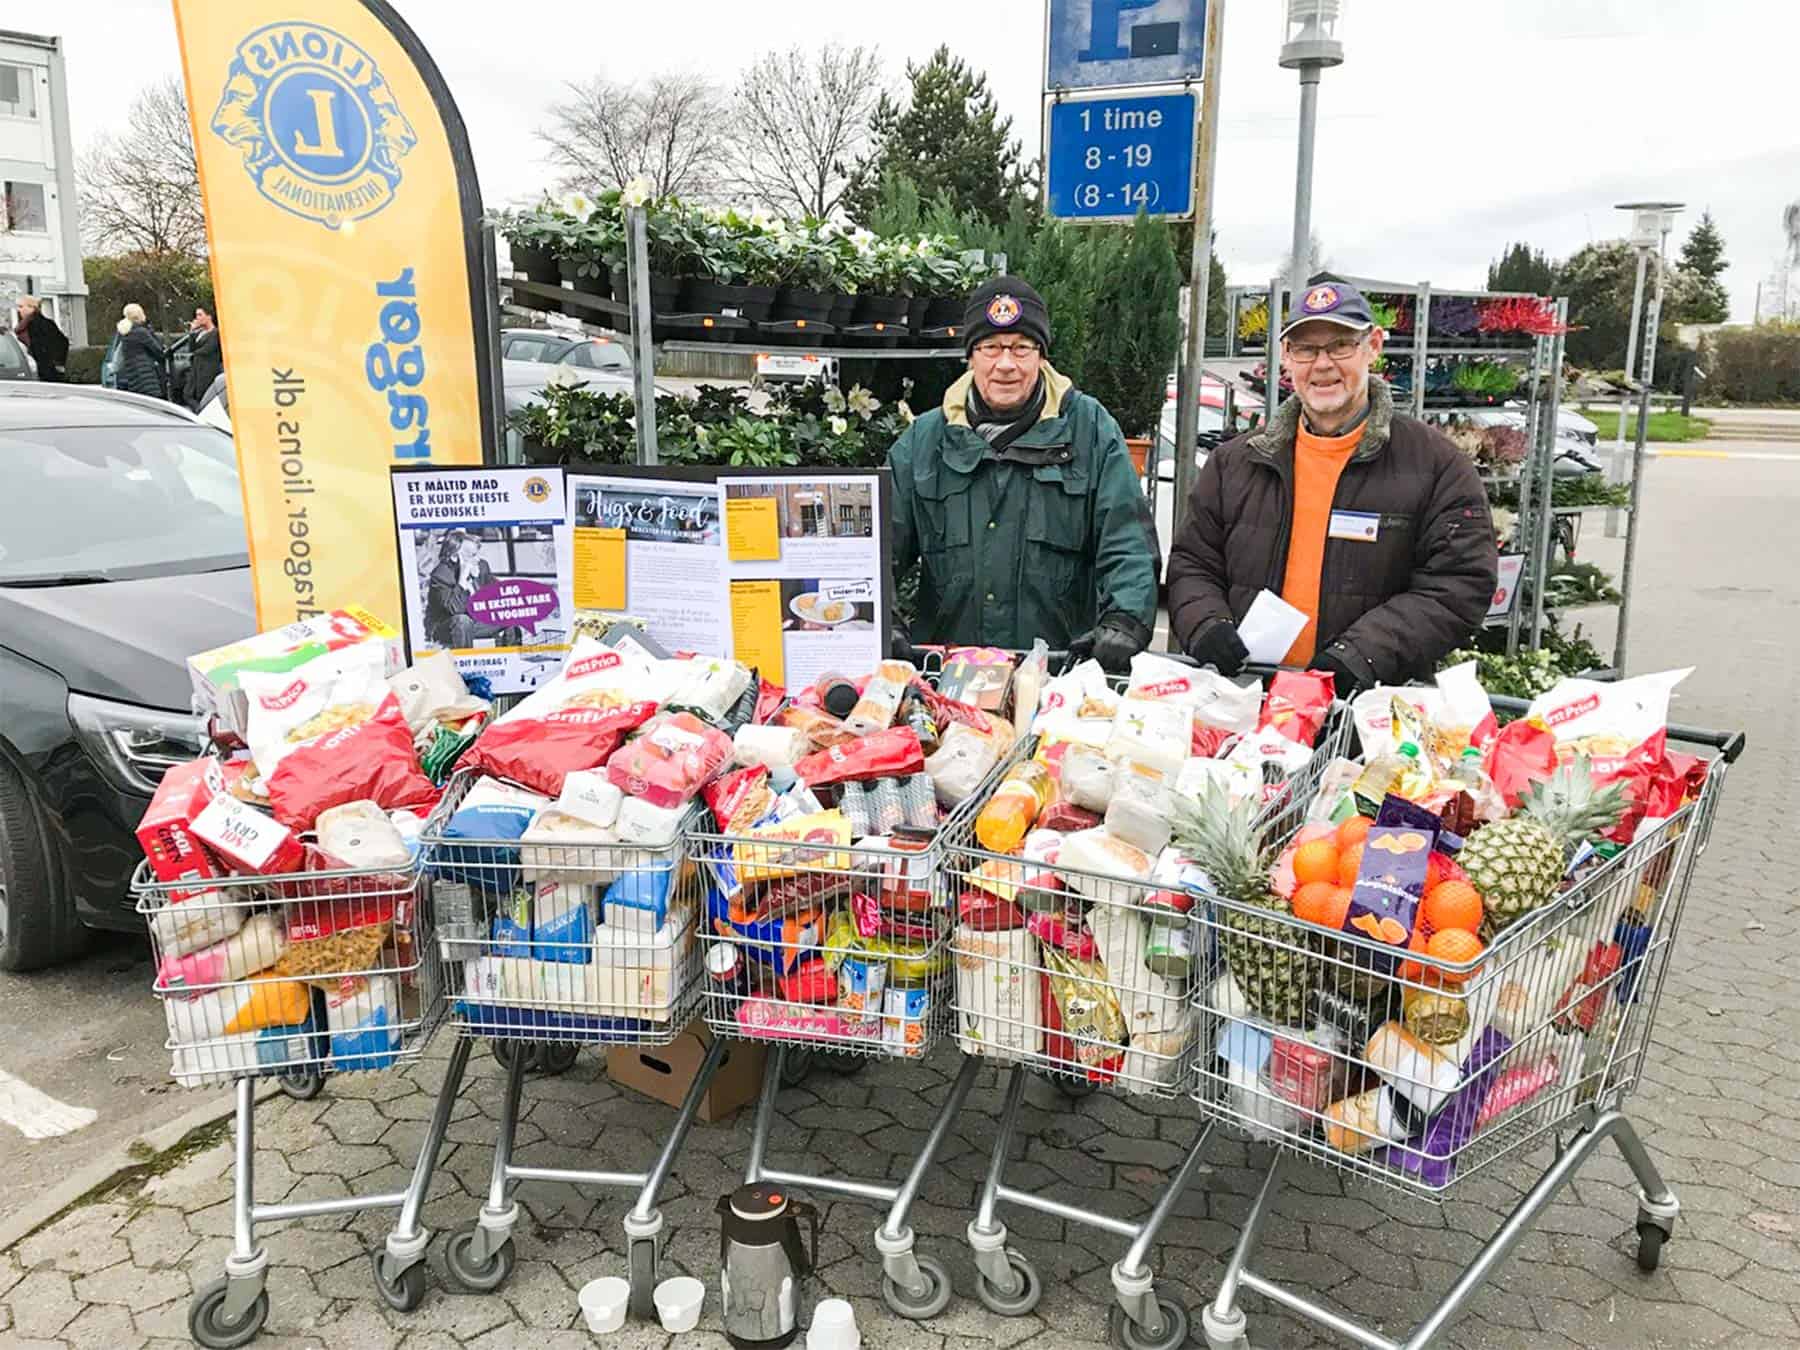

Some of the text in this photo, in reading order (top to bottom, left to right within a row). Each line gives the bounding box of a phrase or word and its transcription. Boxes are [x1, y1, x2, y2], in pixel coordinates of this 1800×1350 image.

[1080, 108, 1163, 132] 1 time
[407, 477, 498, 492] ET MÅLTID MAD
[409, 492, 510, 505] ER KURTS ENESTE
[585, 490, 634, 529] Hugs
[655, 497, 710, 529] Food
[489, 597, 524, 610] EKSTRA
